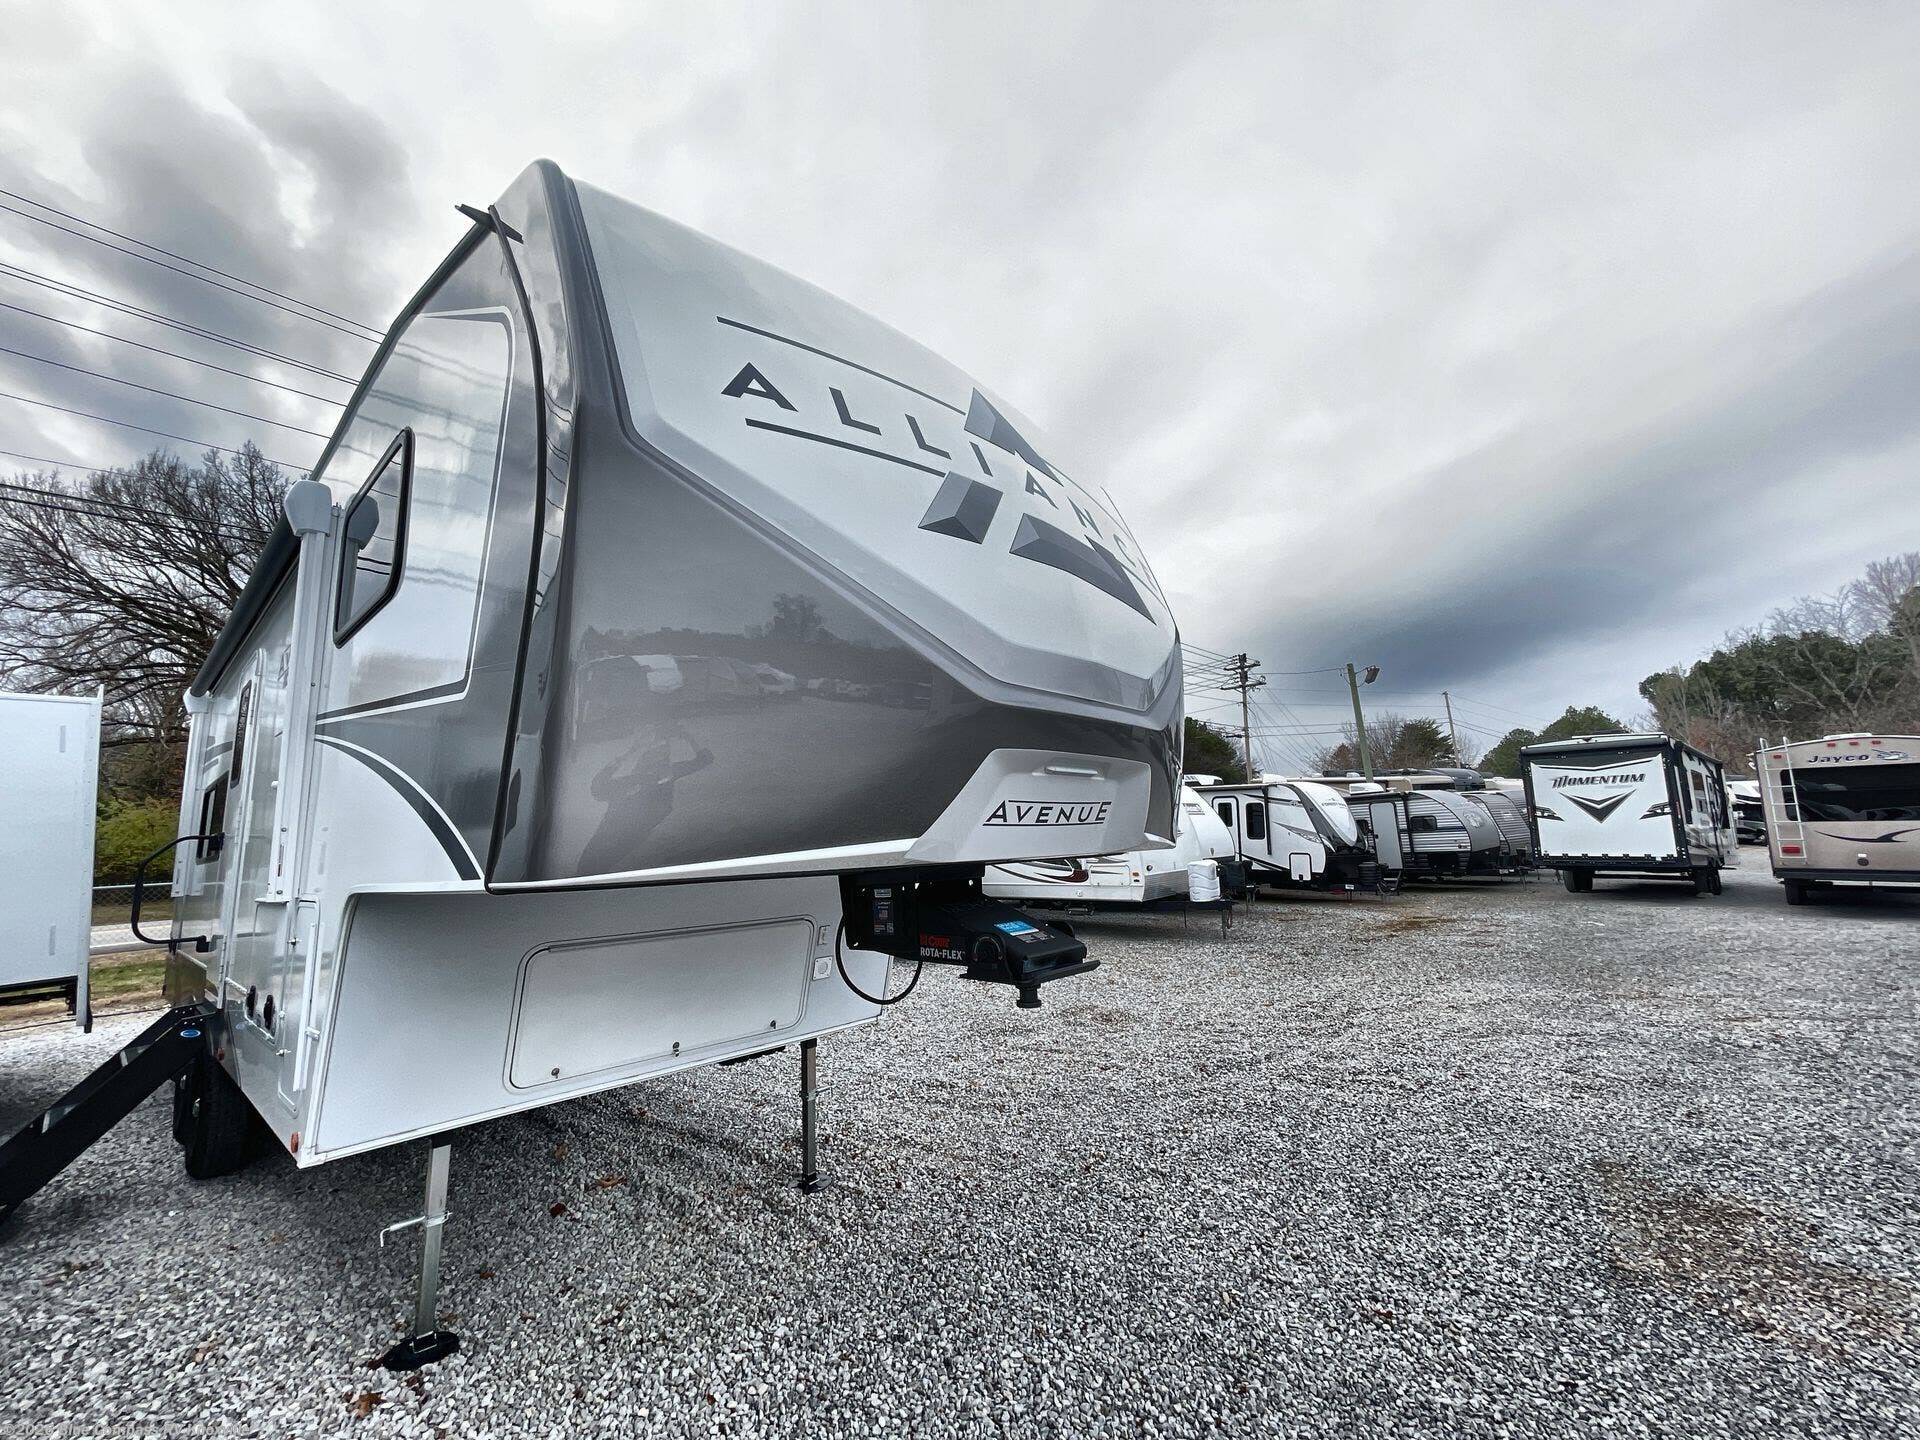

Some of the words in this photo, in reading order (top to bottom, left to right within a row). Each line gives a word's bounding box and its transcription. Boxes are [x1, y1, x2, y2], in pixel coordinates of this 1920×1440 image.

[1808, 755, 1870, 764] Jayco
[1552, 773, 1646, 789] MOMENTUM
[983, 800, 1112, 824] AVENUE
[920, 946, 962, 961] ROTA-FLEX
